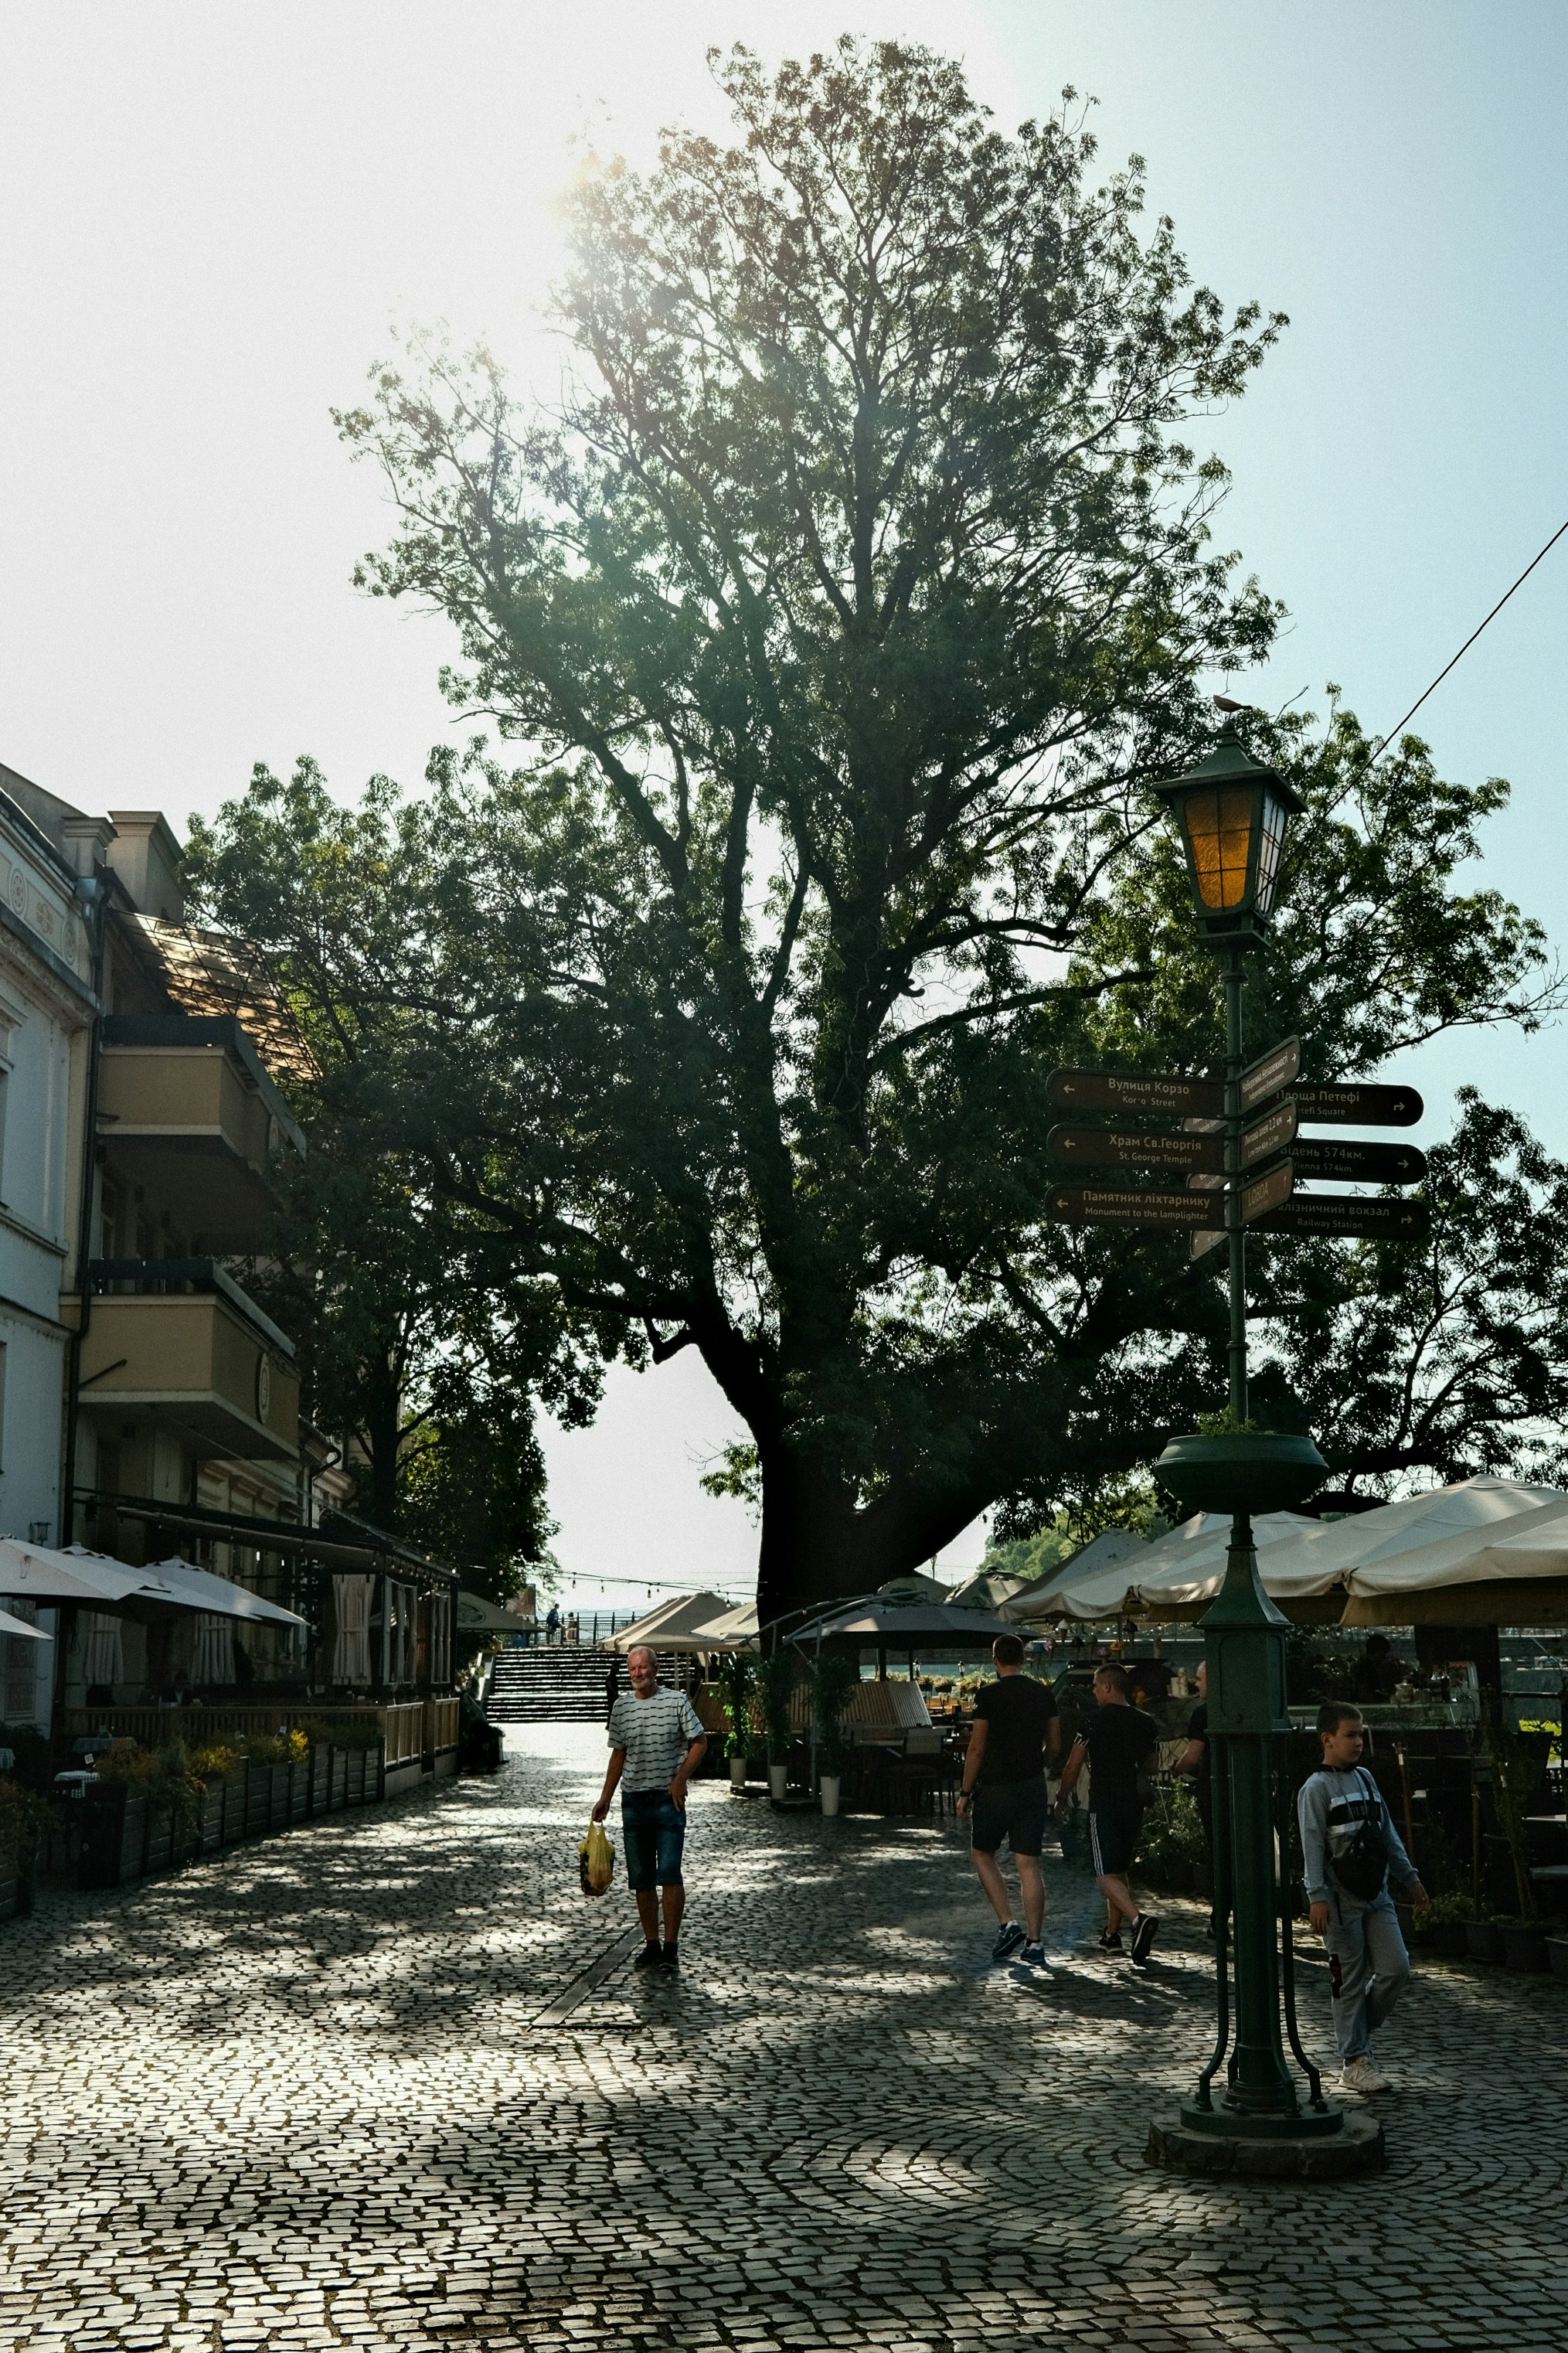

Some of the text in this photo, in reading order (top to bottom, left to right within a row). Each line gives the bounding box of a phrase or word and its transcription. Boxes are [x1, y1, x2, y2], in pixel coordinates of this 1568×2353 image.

[1109, 1078, 1189, 1095] Вулиця Корзо
[1151, 1098, 1176, 1107] Street
[1276, 1090, 1359, 1104] Площа Петефі
[1318, 1107, 1345, 1116] Square
[1109, 1134, 1140, 1147] Храм
[1119, 1152, 1192, 1164] St. George Temple
[1281, 1146, 1365, 1159] Відень 574км.
[1323, 1163, 1353, 1173] 574km.
[1083, 1190, 1210, 1208] Памятник ліхтарнику
[1085, 1207, 1209, 1221] Monument to the lamplighter
[1278, 1201, 1345, 1214] алізничний
[1349, 1206, 1390, 1217] вокзал
[1298, 1217, 1363, 1229] Railway Station
